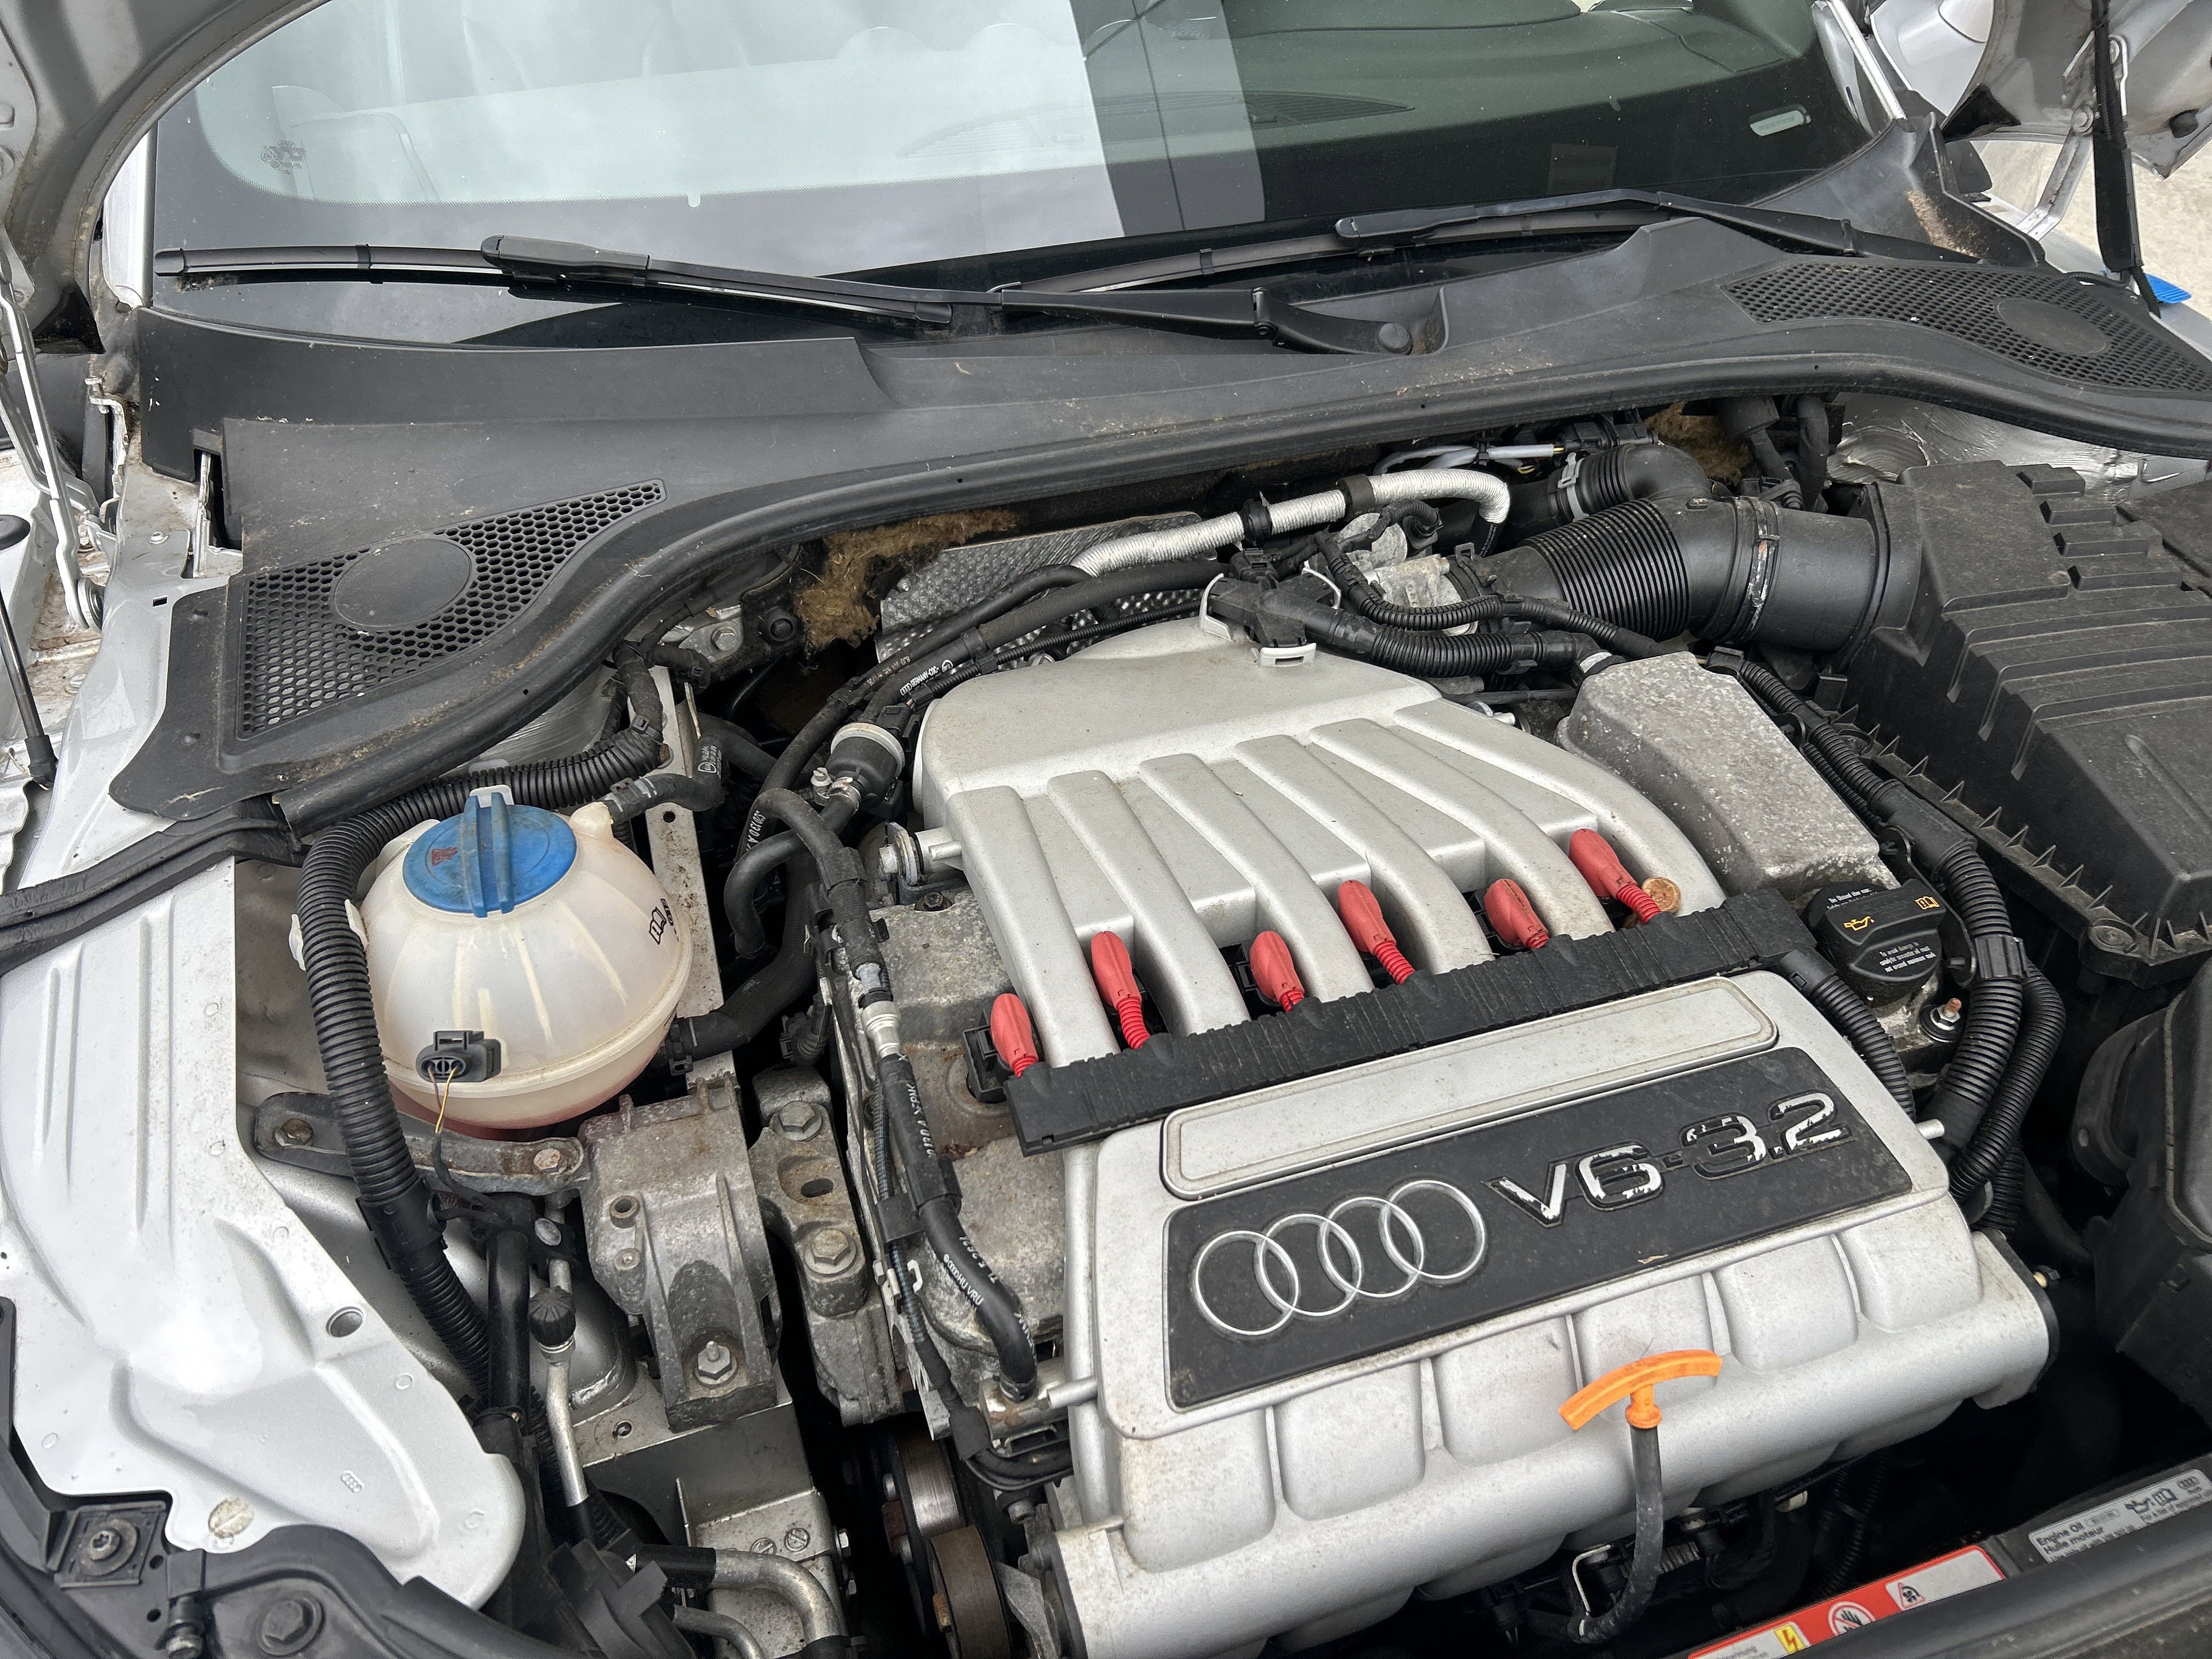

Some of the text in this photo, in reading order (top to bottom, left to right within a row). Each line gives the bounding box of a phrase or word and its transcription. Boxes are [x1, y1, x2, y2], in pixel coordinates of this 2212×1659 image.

[2036, 1521, 2085, 1547] Engine Oil
[2043, 1526, 2105, 1555] Huile moteur
